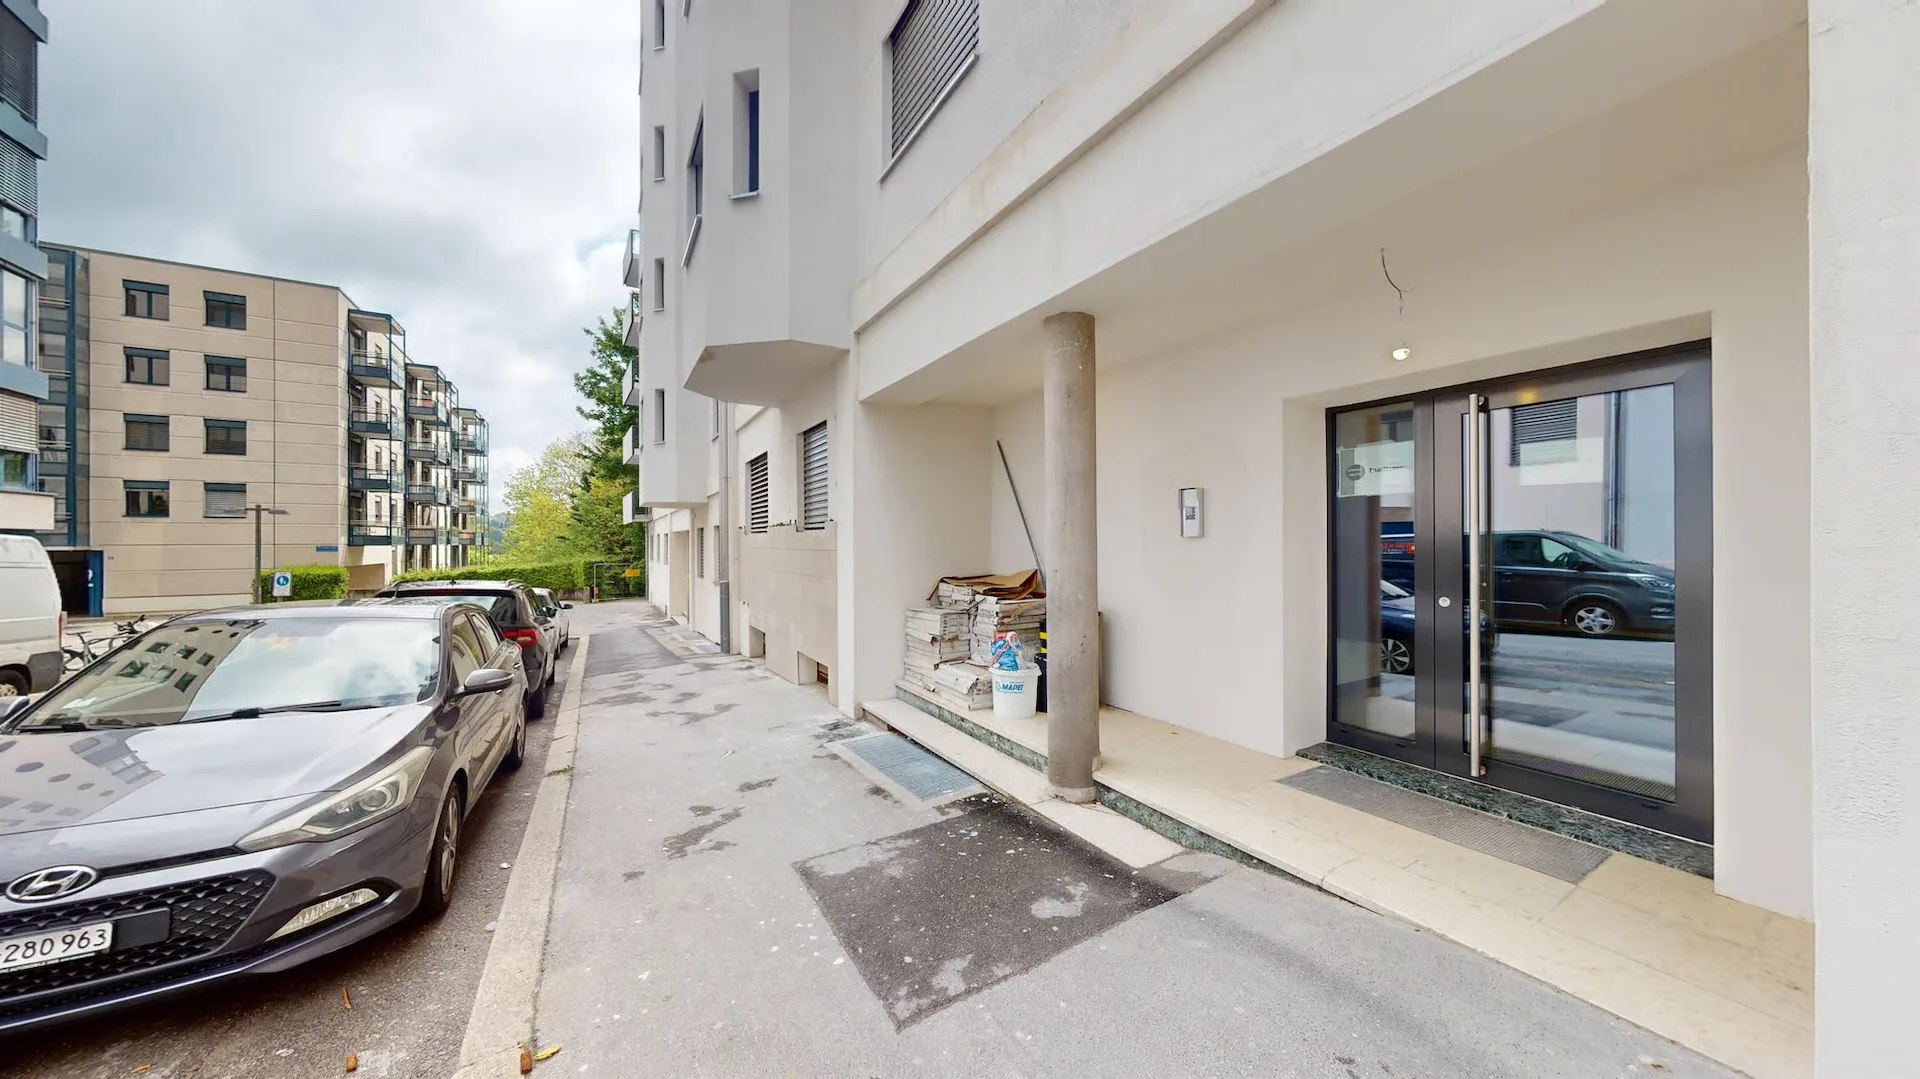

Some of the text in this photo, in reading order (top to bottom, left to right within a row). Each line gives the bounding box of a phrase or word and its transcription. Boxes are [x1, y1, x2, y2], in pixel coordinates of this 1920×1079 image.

[1001, 683, 1024, 691] MAPEI
[3, 938, 55, 963] 280
[61, 929, 106, 953] 963
